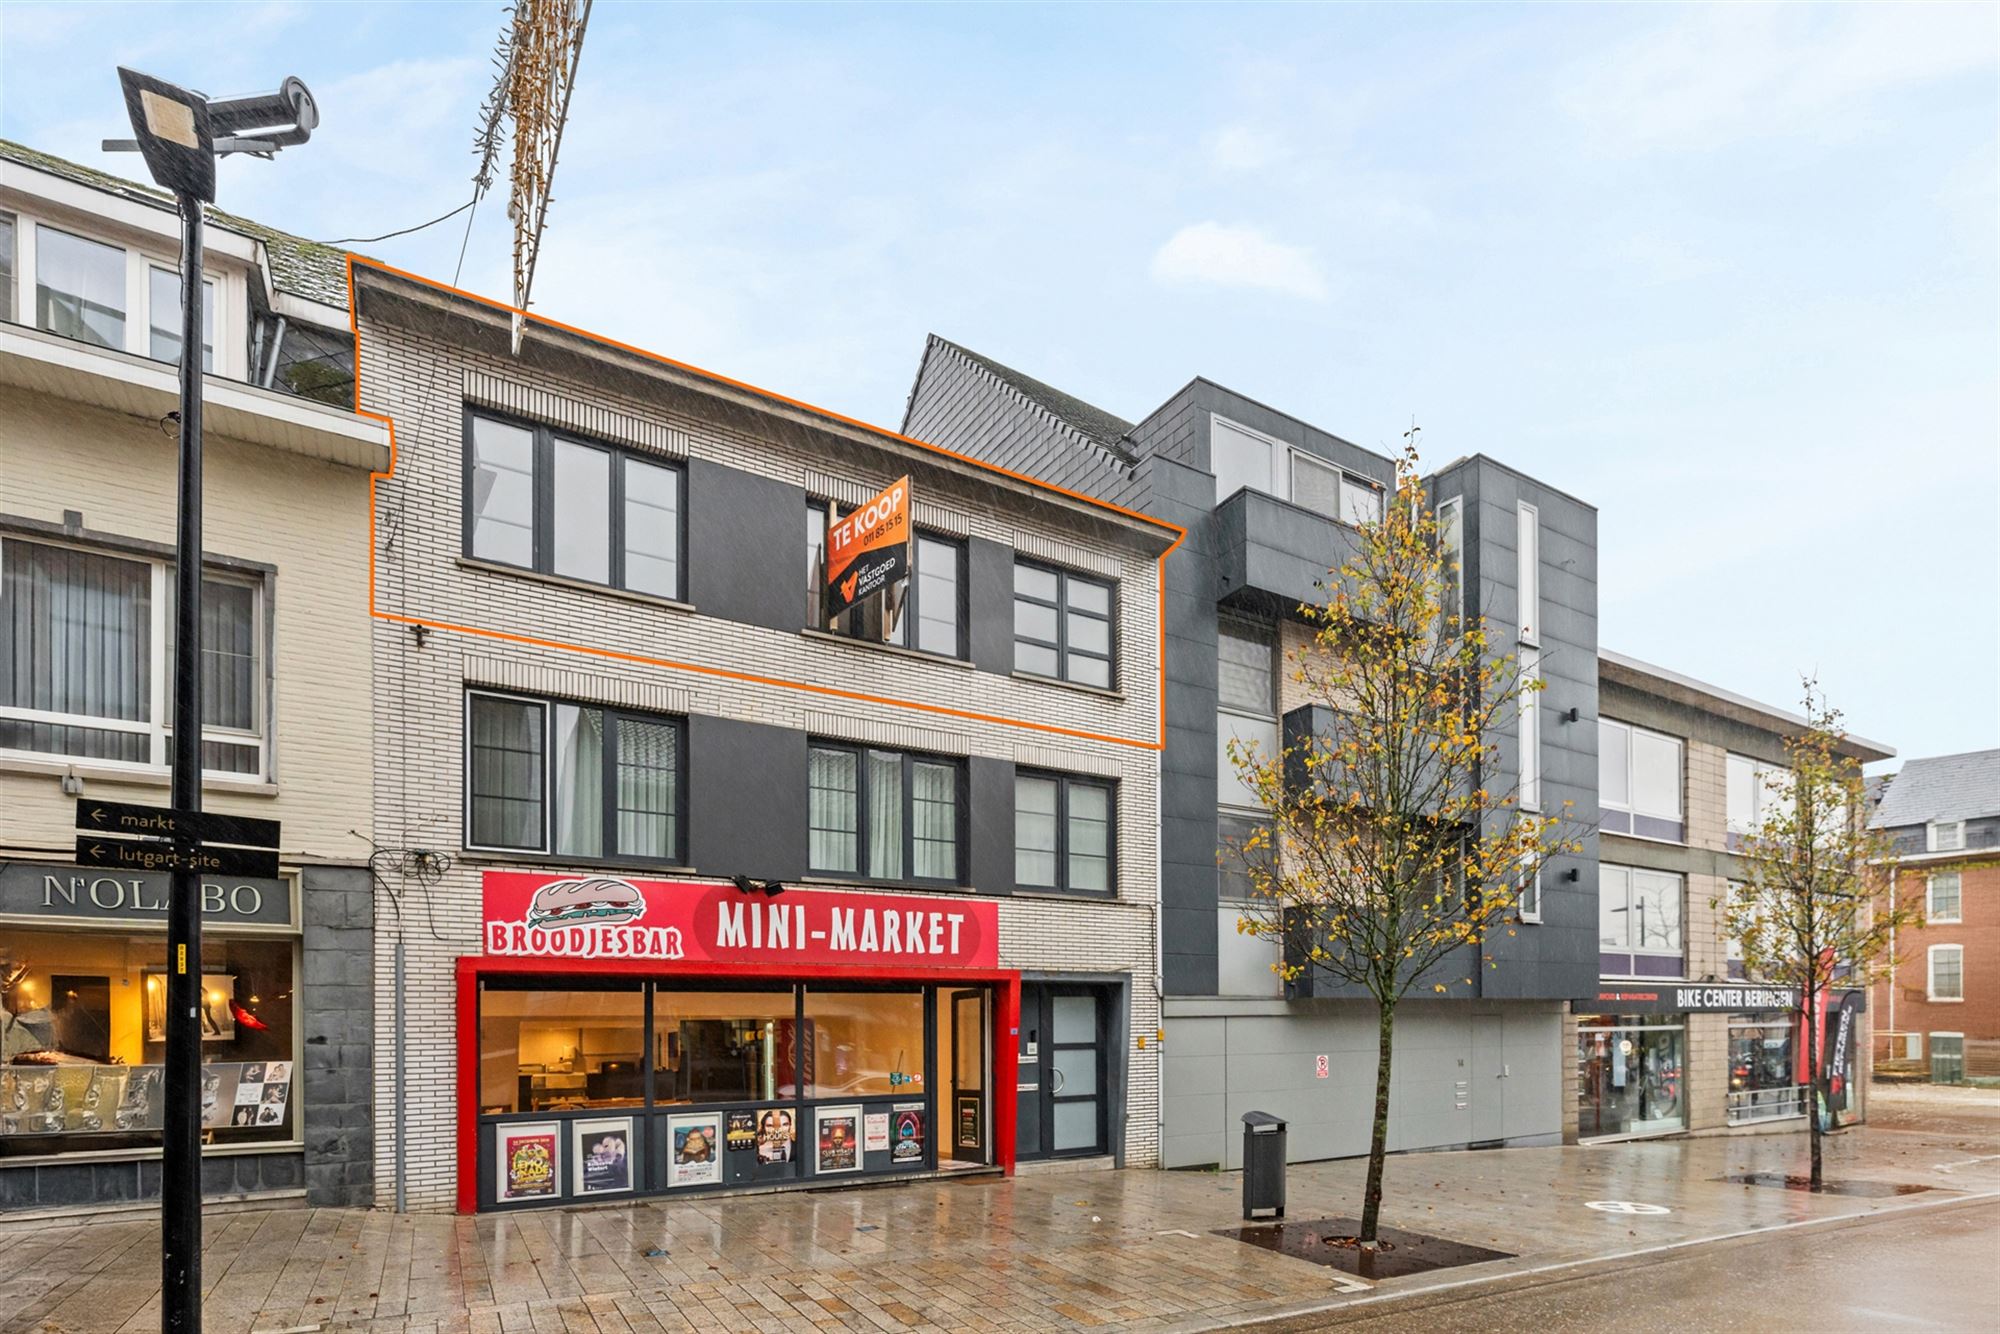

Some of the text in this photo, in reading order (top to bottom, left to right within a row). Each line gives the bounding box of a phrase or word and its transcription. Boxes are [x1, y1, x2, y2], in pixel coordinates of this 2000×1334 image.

[833, 487, 903, 551] TE KOOP
[875, 525, 885, 539] 85
[885, 519, 894, 533] 15
[894, 512, 903, 527] 15
[858, 563, 869, 575] HET
[858, 557, 896, 586] VASTGOED
[858, 574, 885, 596] KANTOOR
[120, 814, 176, 830] markt
[42, 875, 262, 914] N'OLBO
[489, 923, 682, 957] BROODJESBAR
[716, 900, 964, 954] MINI-MARKET
[1676, 989, 1702, 1008] BIKE
[1703, 989, 1743, 1008] CENTER
